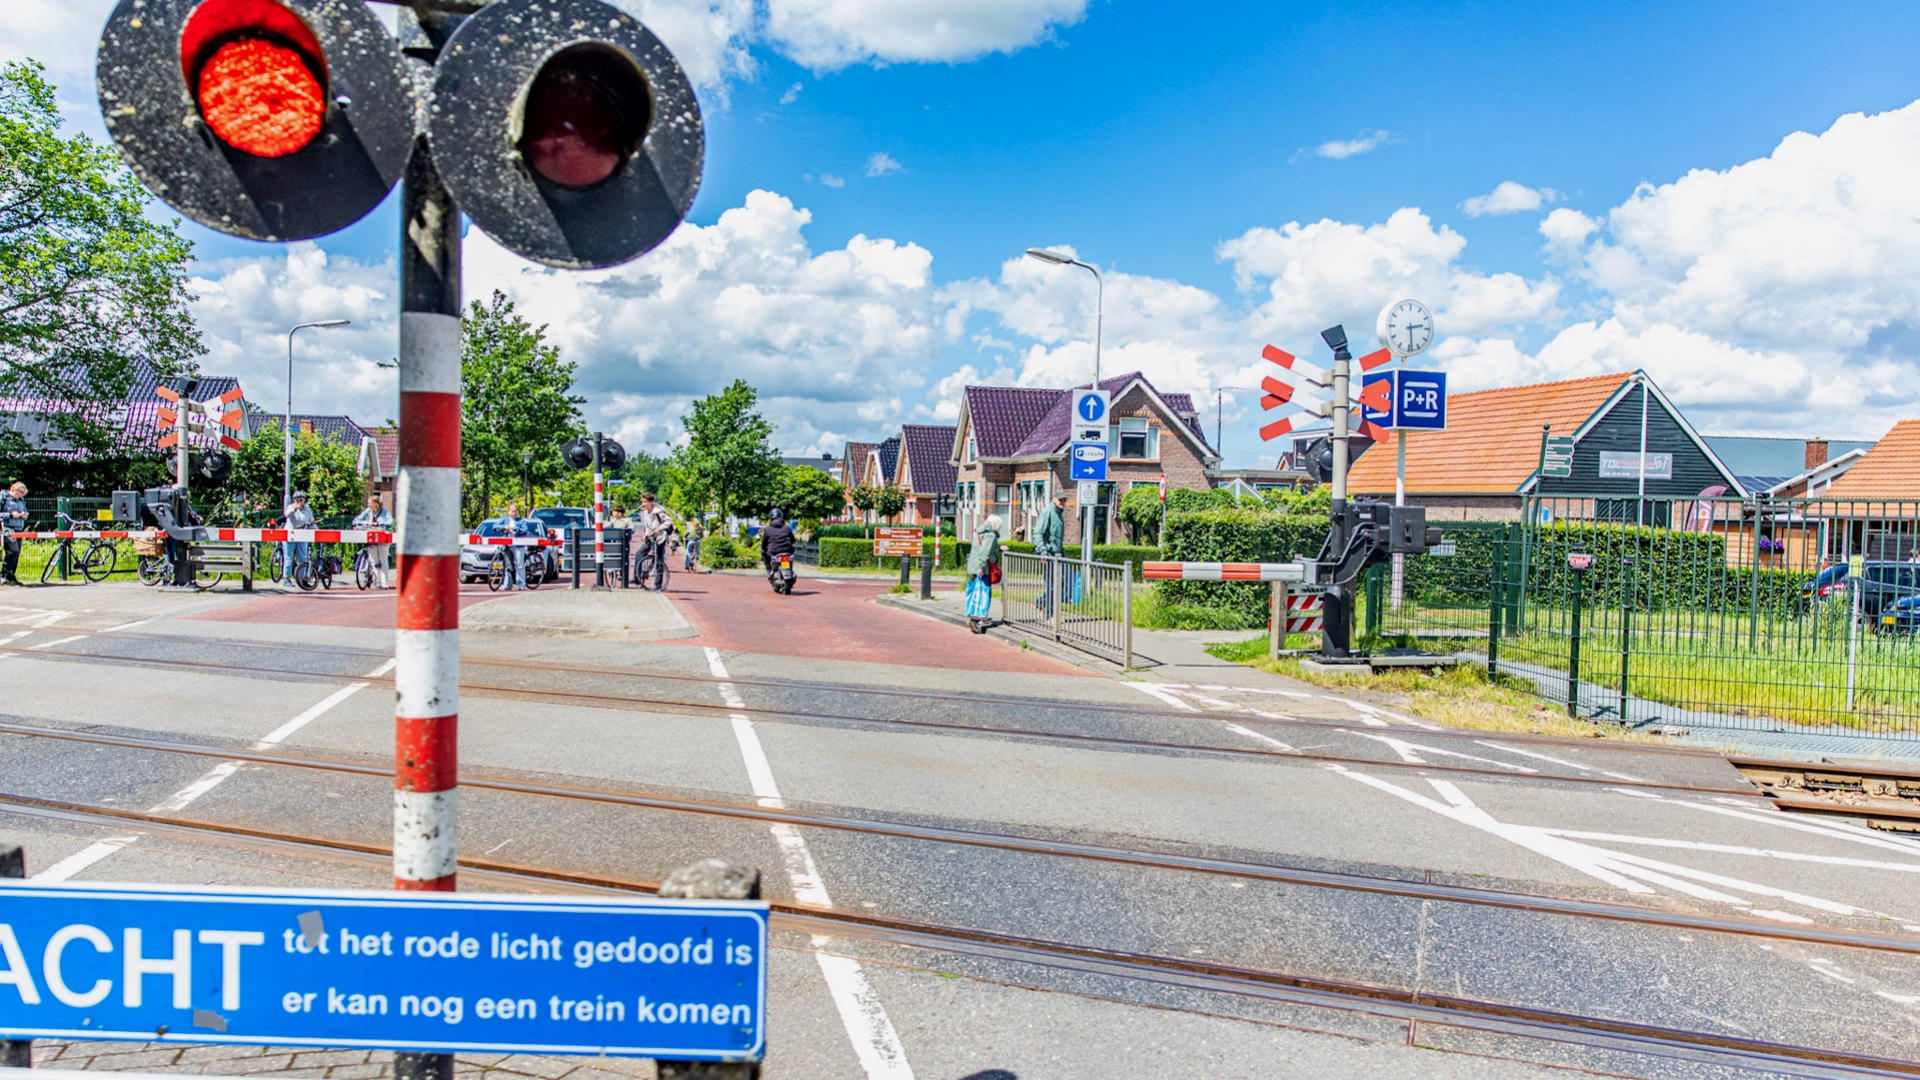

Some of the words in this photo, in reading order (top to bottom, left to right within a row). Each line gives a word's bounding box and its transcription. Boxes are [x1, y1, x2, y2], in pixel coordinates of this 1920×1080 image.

[1403, 388, 1439, 410] P+R
[283, 928, 329, 954] tot
[340, 928, 393, 956] het
[404, 931, 480, 959] rode
[491, 932, 562, 960] licht
[573, 936, 713, 968] gedoofd
[726, 939, 752, 965] is
[282, 991, 317, 1013] er
[328, 987, 388, 1015] kan
[400, 995, 464, 1024] nog
[475, 997, 536, 1019] een
[549, 995, 625, 1022] trein
[638, 996, 751, 1025] komen
